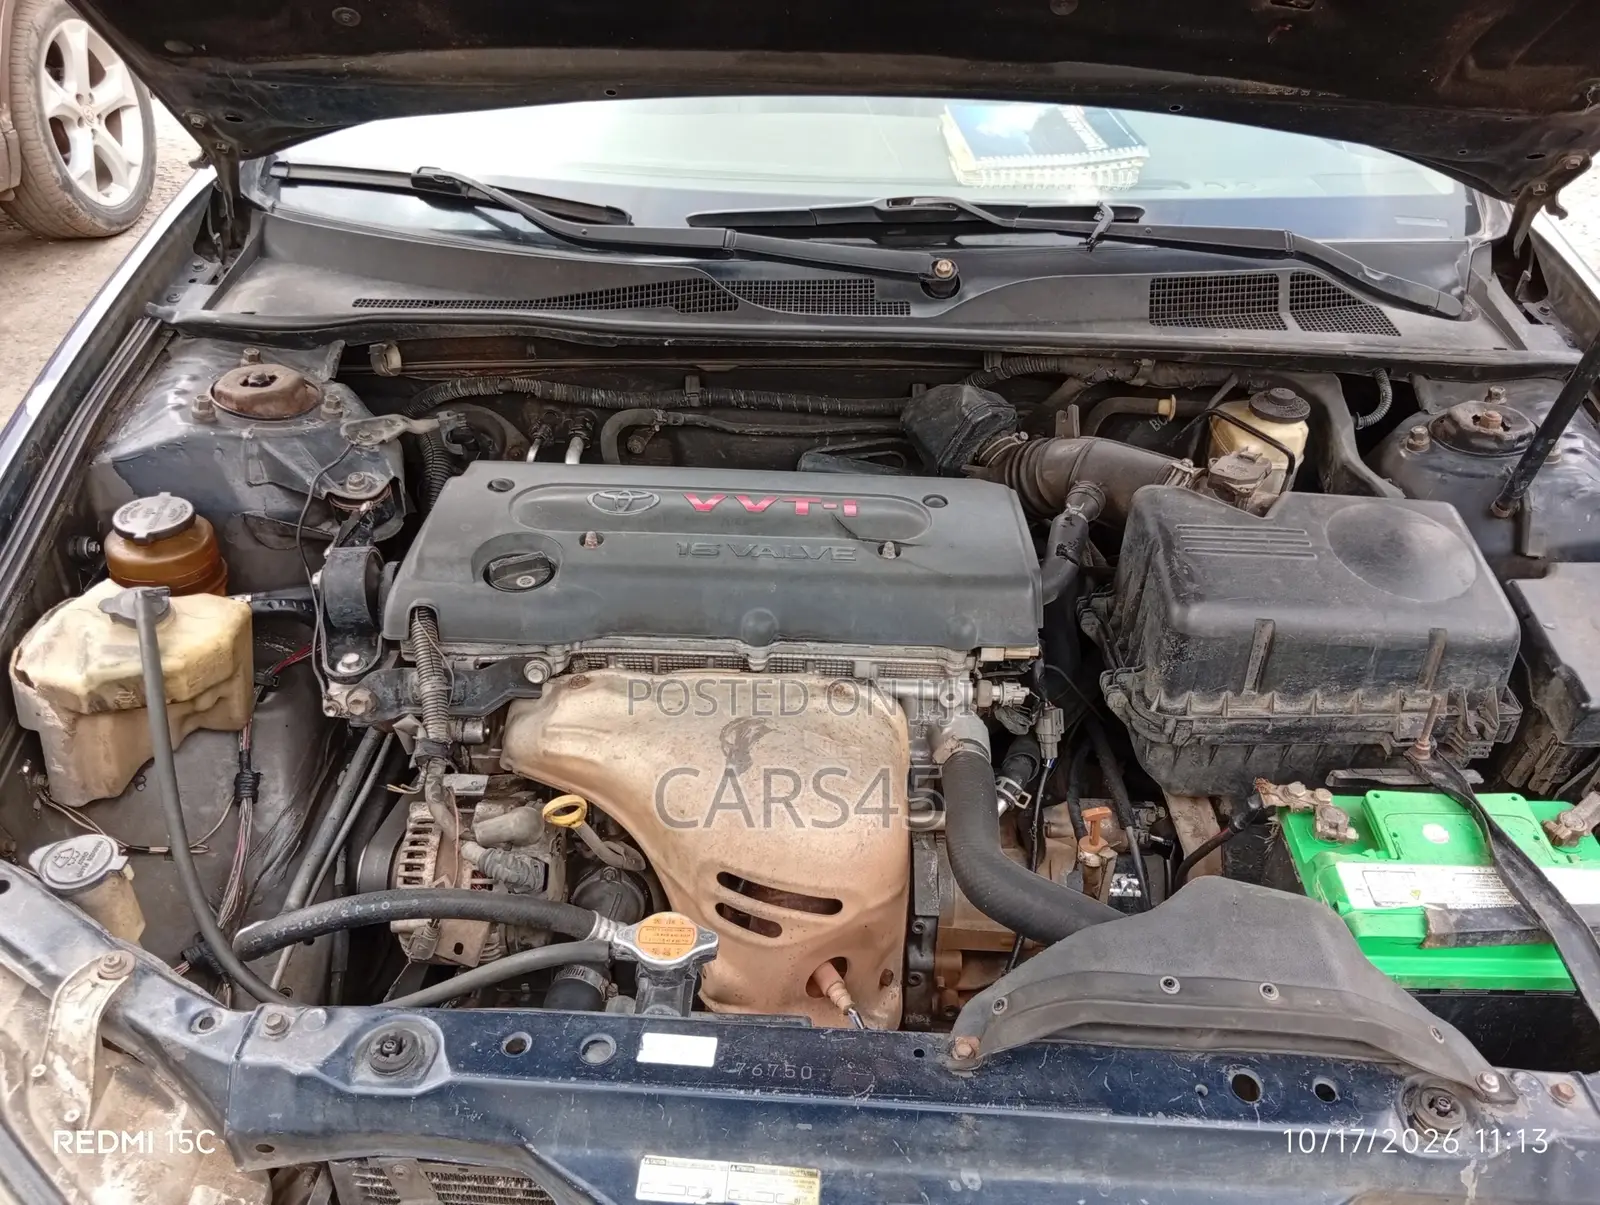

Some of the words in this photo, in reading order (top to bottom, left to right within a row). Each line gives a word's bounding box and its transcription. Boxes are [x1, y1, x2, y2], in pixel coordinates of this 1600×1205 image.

[676, 541, 721, 558] 16
[727, 542, 857, 562] VALVE
[736, 1062, 813, 1080] 76750
